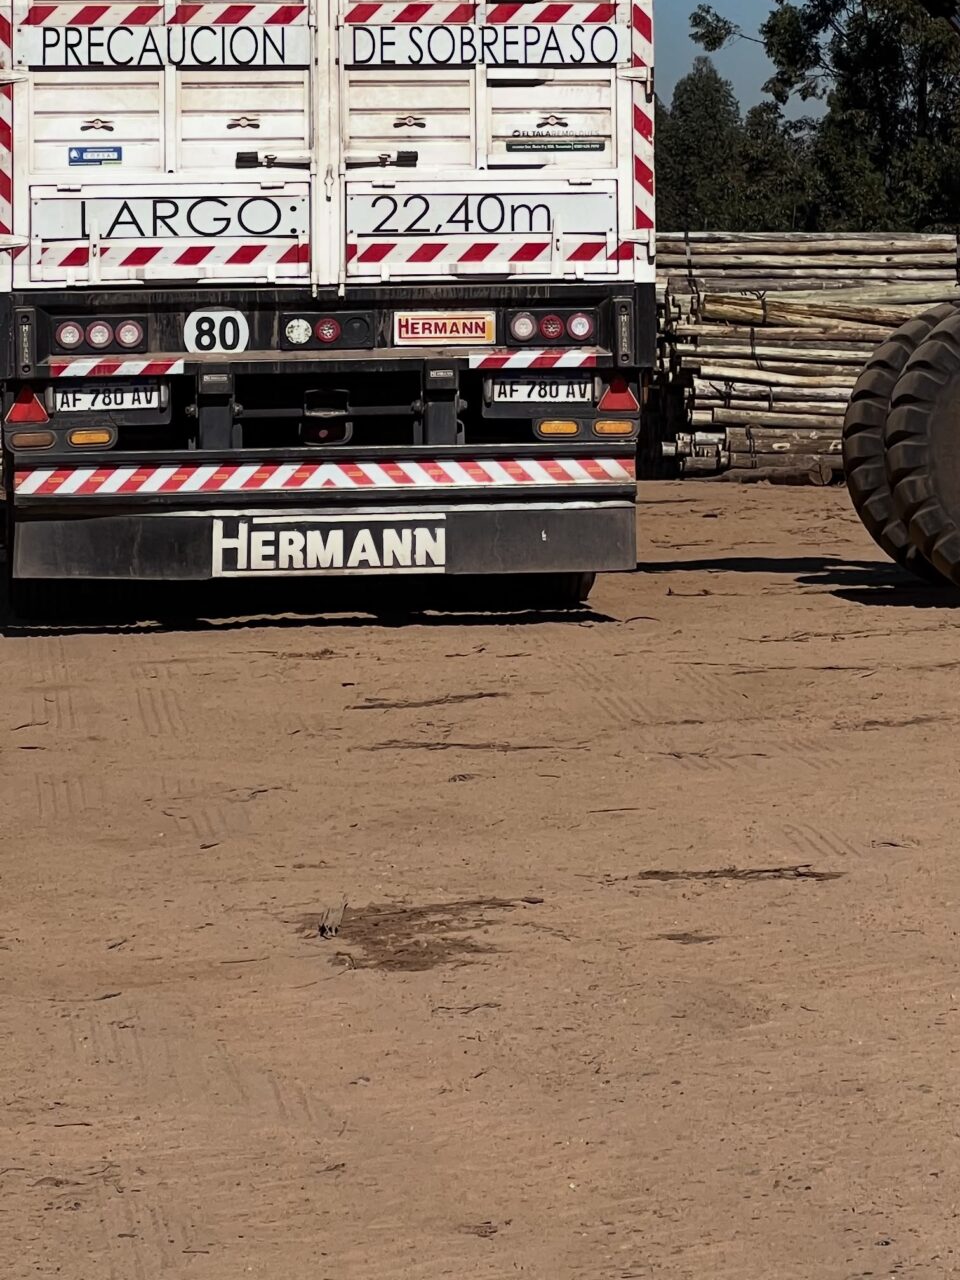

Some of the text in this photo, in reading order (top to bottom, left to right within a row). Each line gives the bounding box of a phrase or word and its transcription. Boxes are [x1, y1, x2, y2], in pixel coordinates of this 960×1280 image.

[42, 26, 285, 65] PRECAUCION
[353, 24, 618, 64] DE SOBREPASO
[81, 196, 297, 237] LARGO:
[371, 194, 551, 233] 22,40m
[195, 316, 240, 351] 80
[398, 318, 486, 339] HERMANN
[60, 387, 154, 408] AF 780 AV
[498, 380, 587, 398] AF 780 AV
[212, 519, 446, 577] HERMANN
